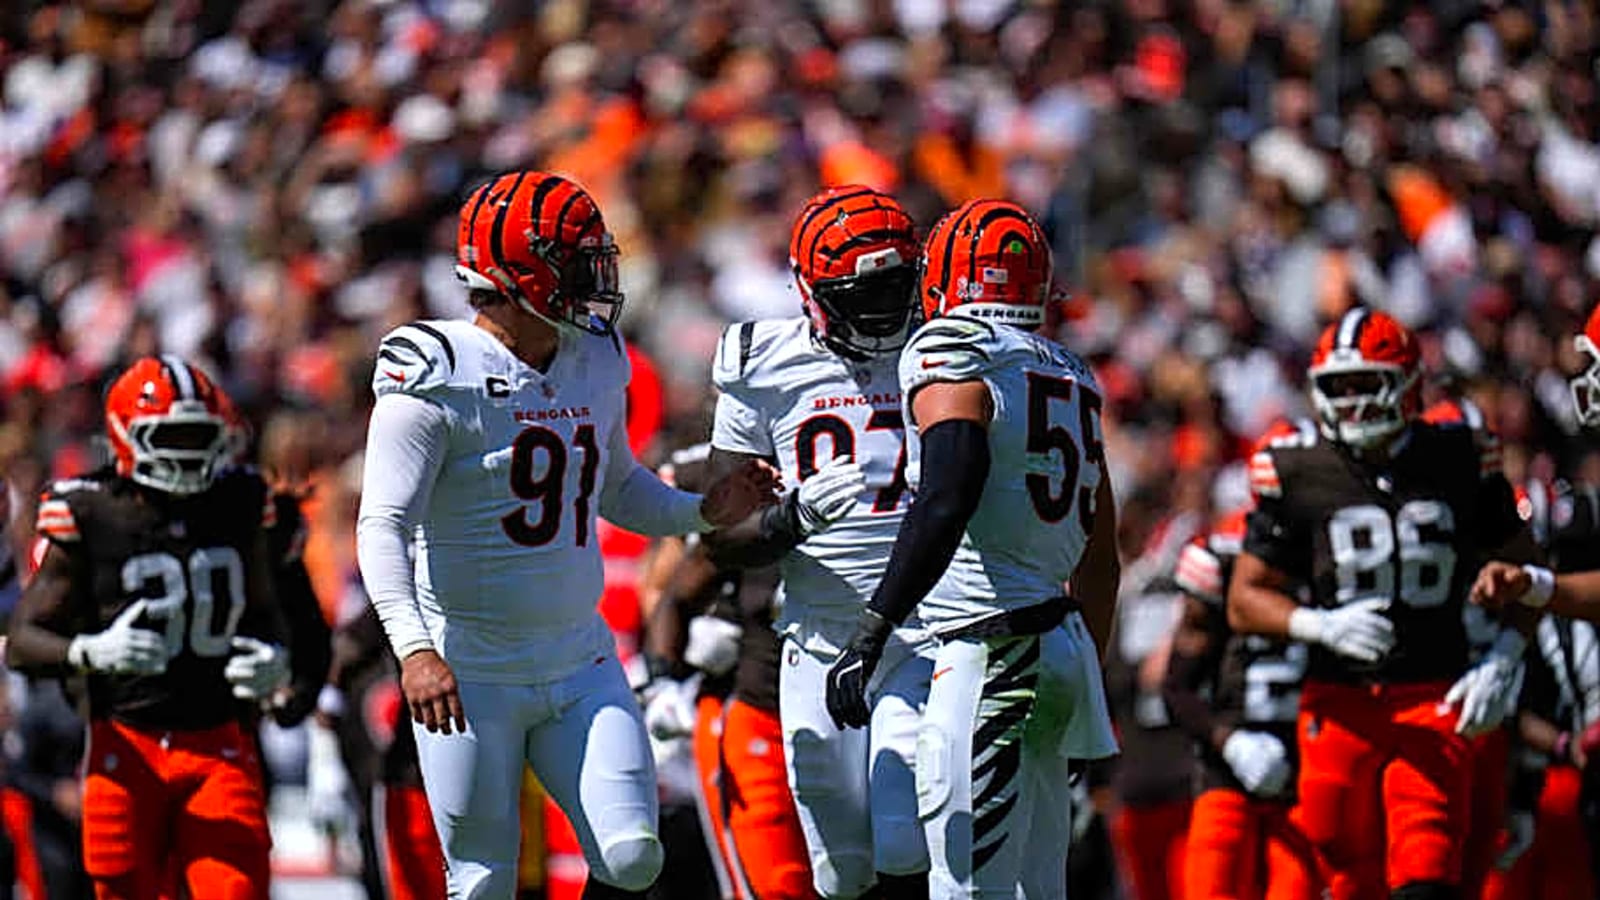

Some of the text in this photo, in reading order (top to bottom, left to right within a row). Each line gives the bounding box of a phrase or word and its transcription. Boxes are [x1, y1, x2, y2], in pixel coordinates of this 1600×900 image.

[486, 377, 510, 398] C
[513, 407, 590, 421] BENGALS
[501, 422, 599, 548] 91
[122, 546, 246, 658] 30
[1329, 500, 1457, 608] 86
